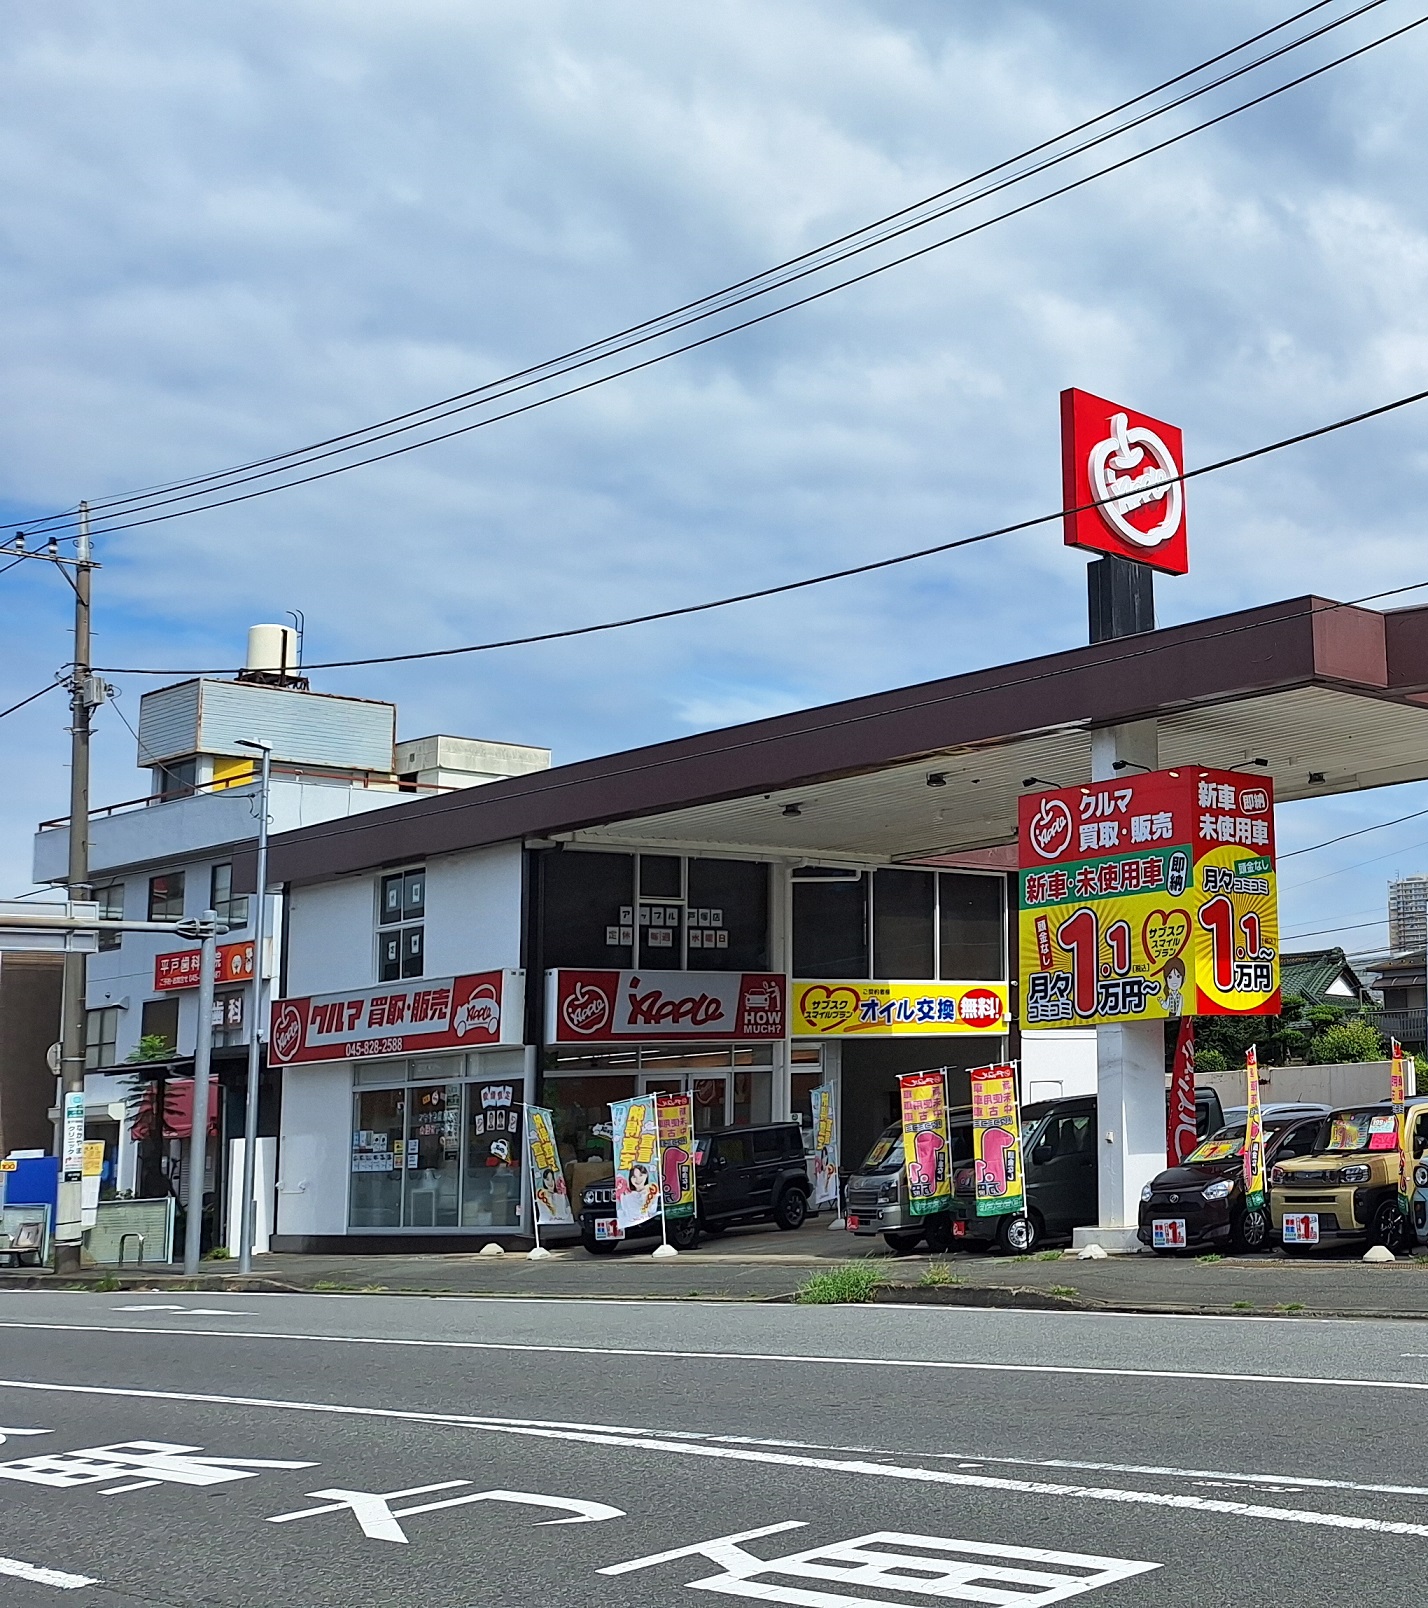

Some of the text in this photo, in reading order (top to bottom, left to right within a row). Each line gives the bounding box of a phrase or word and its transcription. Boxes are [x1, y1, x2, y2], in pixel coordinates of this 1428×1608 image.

[1079, 788, 1133, 820] クルマ
[1198, 781, 1236, 811] 新車
[1242, 793, 1266, 812] 即納
[1079, 812, 1173, 852] 買取・販売
[1199, 814, 1269, 846] 未使用車
[1169, 855, 1185, 894] 即納
[1237, 858, 1270, 876] 頭金なし
[1026, 856, 1164, 904] 新車・未使用車
[1202, 866, 1233, 894] 月々
[1233, 876, 1270, 896] コミコミ
[1036, 921, 1051, 967] 頭金なし
[1148, 925, 1185, 940] サブスク
[1152, 938, 1181, 948] スマイル
[160, 952, 222, 975] 平戸歯科院
[1154, 948, 1176, 959] プラン
[1028, 972, 1073, 1003] 月々
[1234, 962, 1273, 993] 万円
[311, 989, 451, 1035] クルマ 買取・販売
[804, 1011, 853, 1020] スマイルプラン
[811, 1000, 848, 1010] サブスク
[860, 997, 957, 1025] オイル交換
[1027, 1000, 1073, 1022] コミコミ
[744, 1012, 781, 1024] HOW
[744, 1025, 781, 1034] MUCH?
[345, 1038, 403, 1057] 045-828-2588
